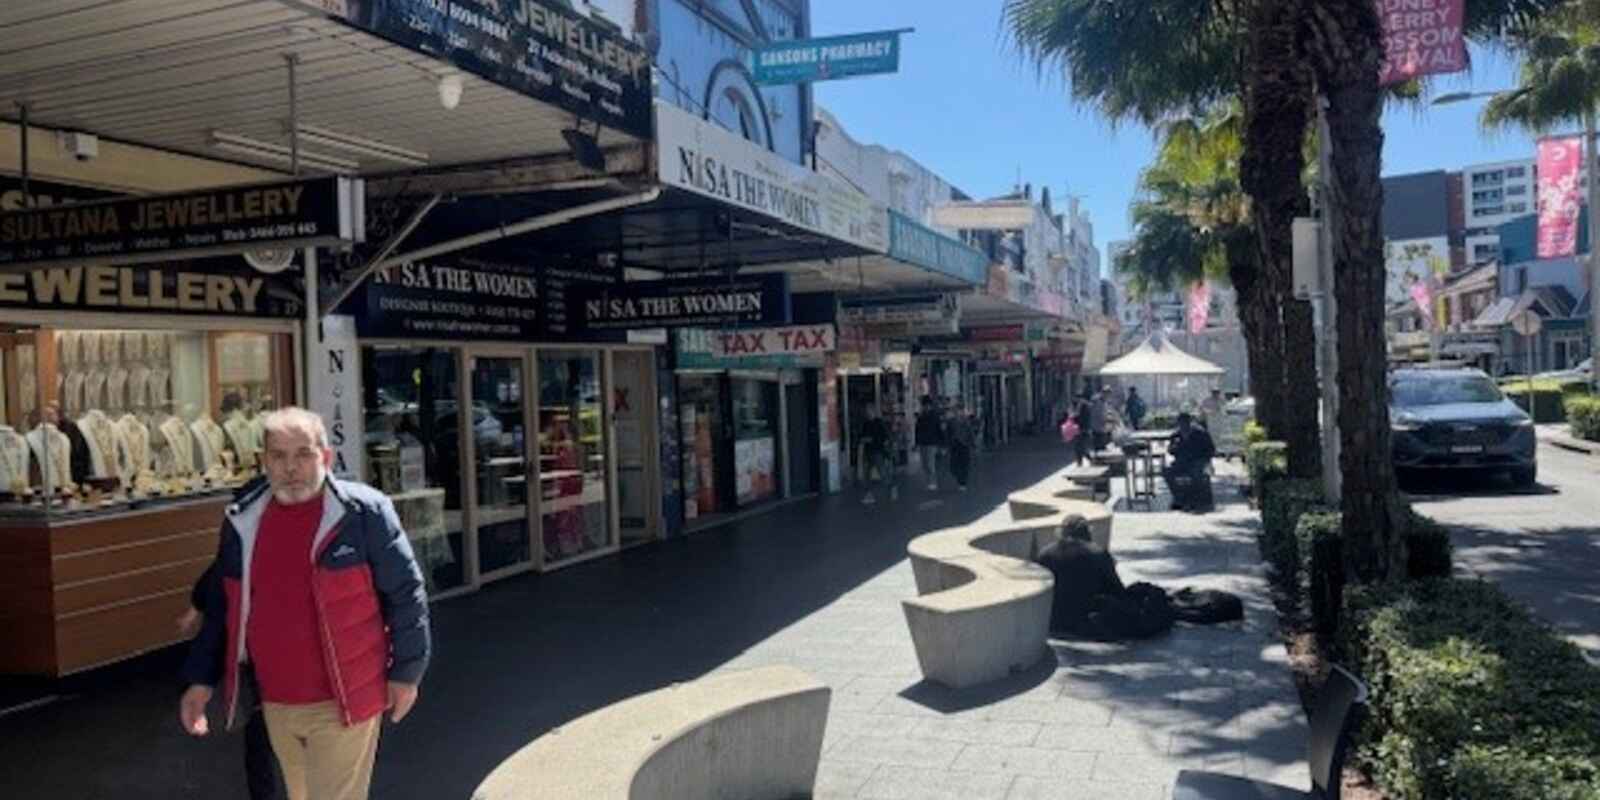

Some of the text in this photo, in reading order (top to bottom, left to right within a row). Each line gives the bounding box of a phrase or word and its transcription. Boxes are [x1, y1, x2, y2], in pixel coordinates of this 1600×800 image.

[513, 0, 648, 87] JEWELLERY
[820, 40, 892, 61] PHARMACY
[2, 185, 304, 241] SULTANA JEWELLERY
[733, 170, 768, 210] THE
[769, 184, 821, 229] WOMEN
[432, 266, 472, 293] THE
[473, 271, 539, 299] WOMEN
[638, 296, 680, 317] THE
[683, 291, 763, 315] WOMEN
[718, 328, 827, 355] TAX TAX
